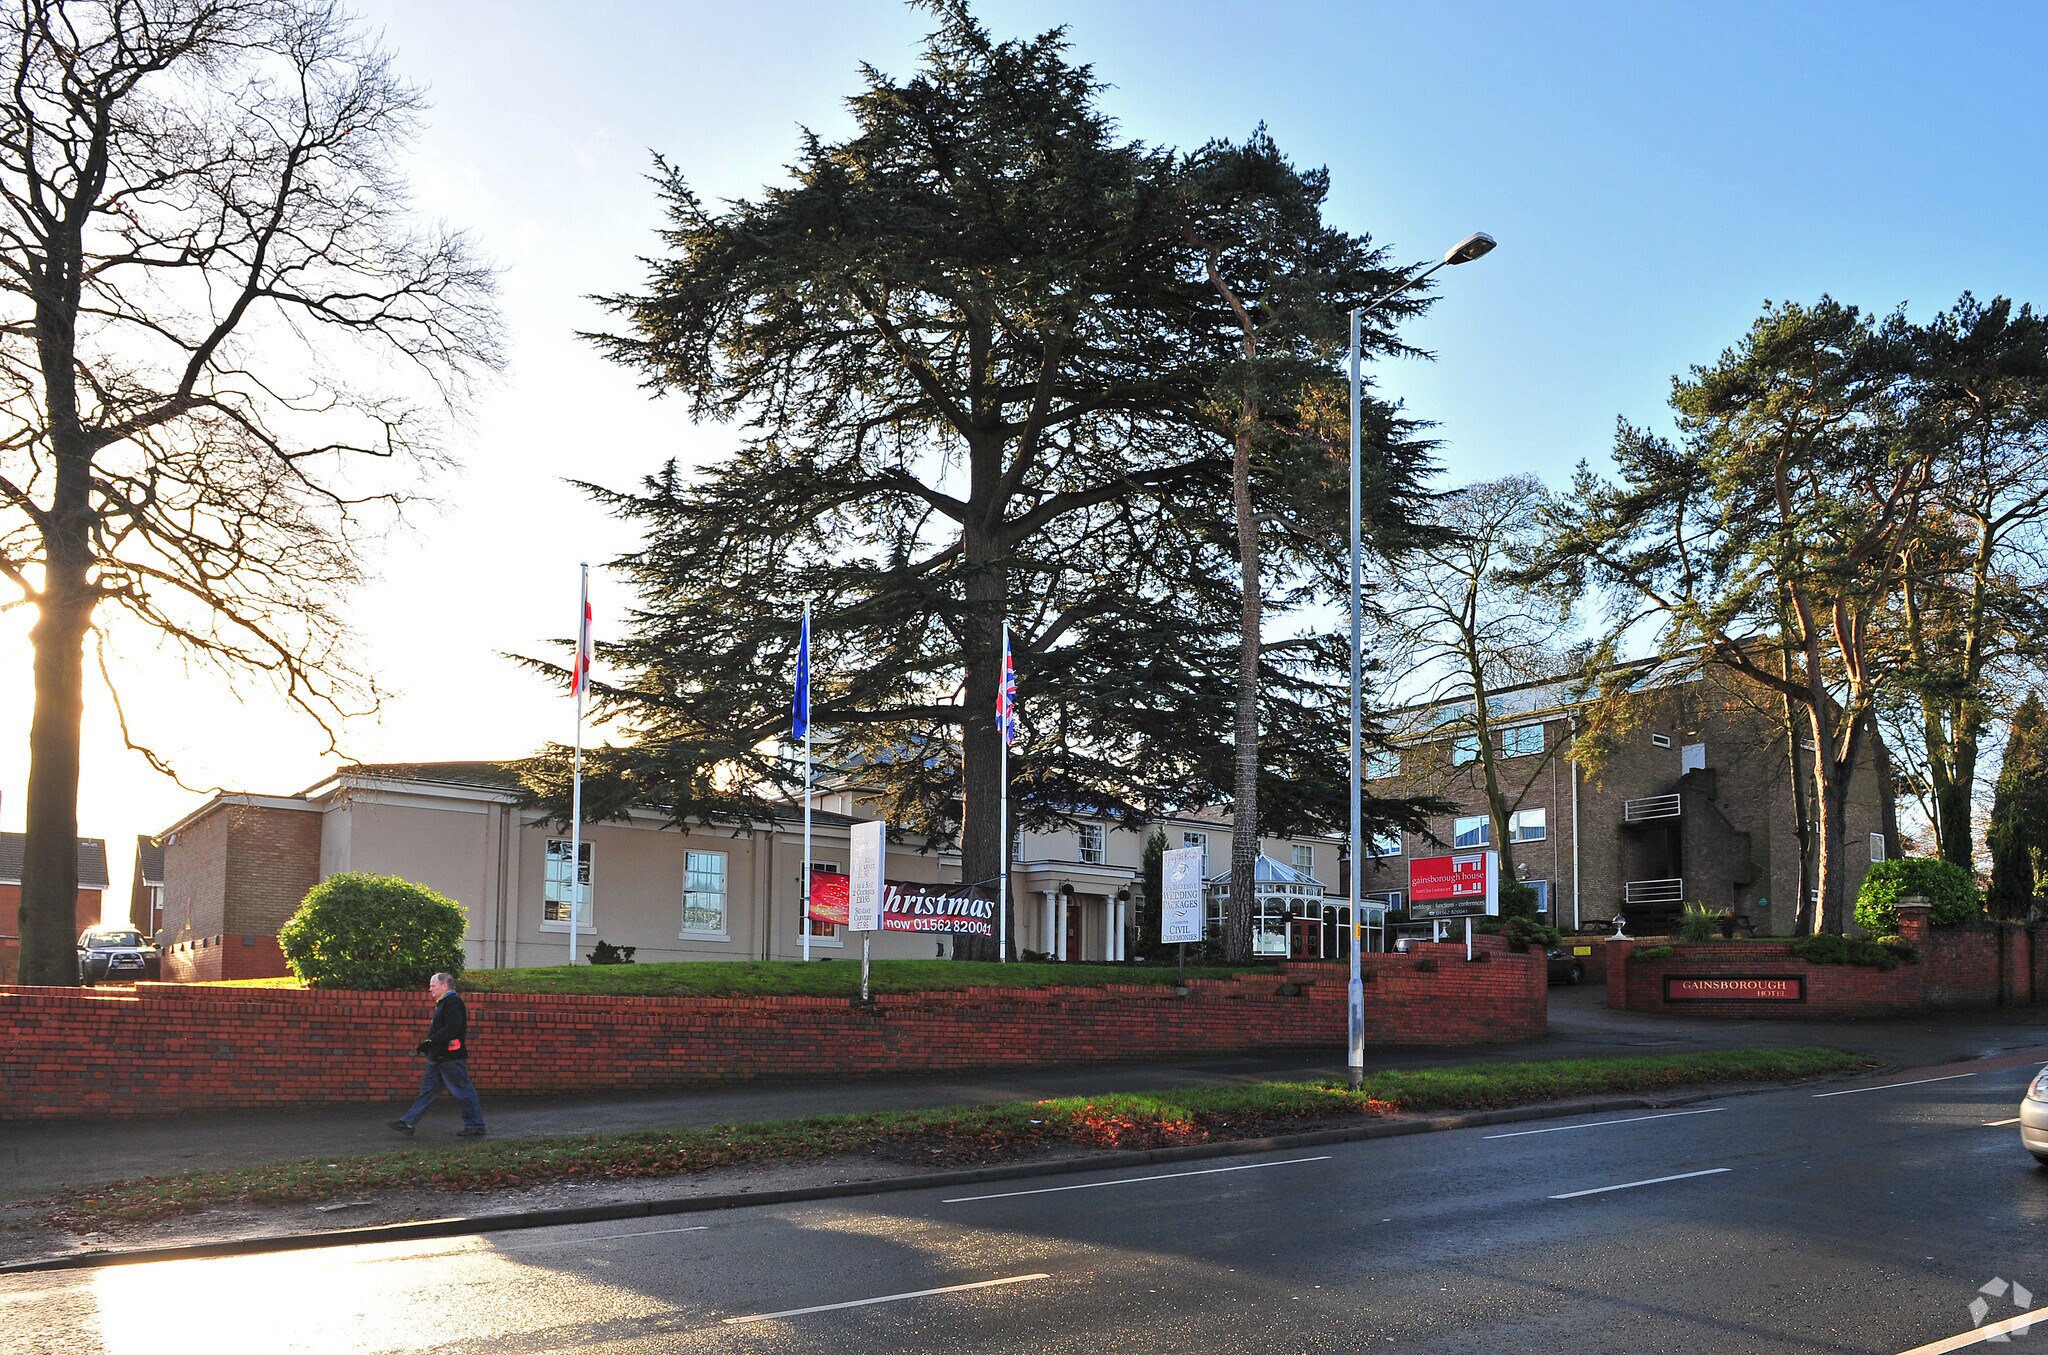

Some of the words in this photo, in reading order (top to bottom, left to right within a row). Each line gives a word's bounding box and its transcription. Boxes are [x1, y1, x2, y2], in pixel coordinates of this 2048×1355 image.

[1411, 873, 1460, 886] gainsborough
[1462, 871, 1484, 880] house
[1163, 890, 1198, 900] WEDDING
[882, 884, 995, 919] hristmas
[1163, 900, 1198, 909] PACKAGES
[886, 919, 910, 930] now
[914, 918, 952, 932] 01562
[953, 920, 992, 937] 820041
[1169, 925, 1190, 935] CIVIL
[1163, 934, 1198, 942] CEREMONIES
[1682, 981, 1786, 990] GAINSBOROUGH
